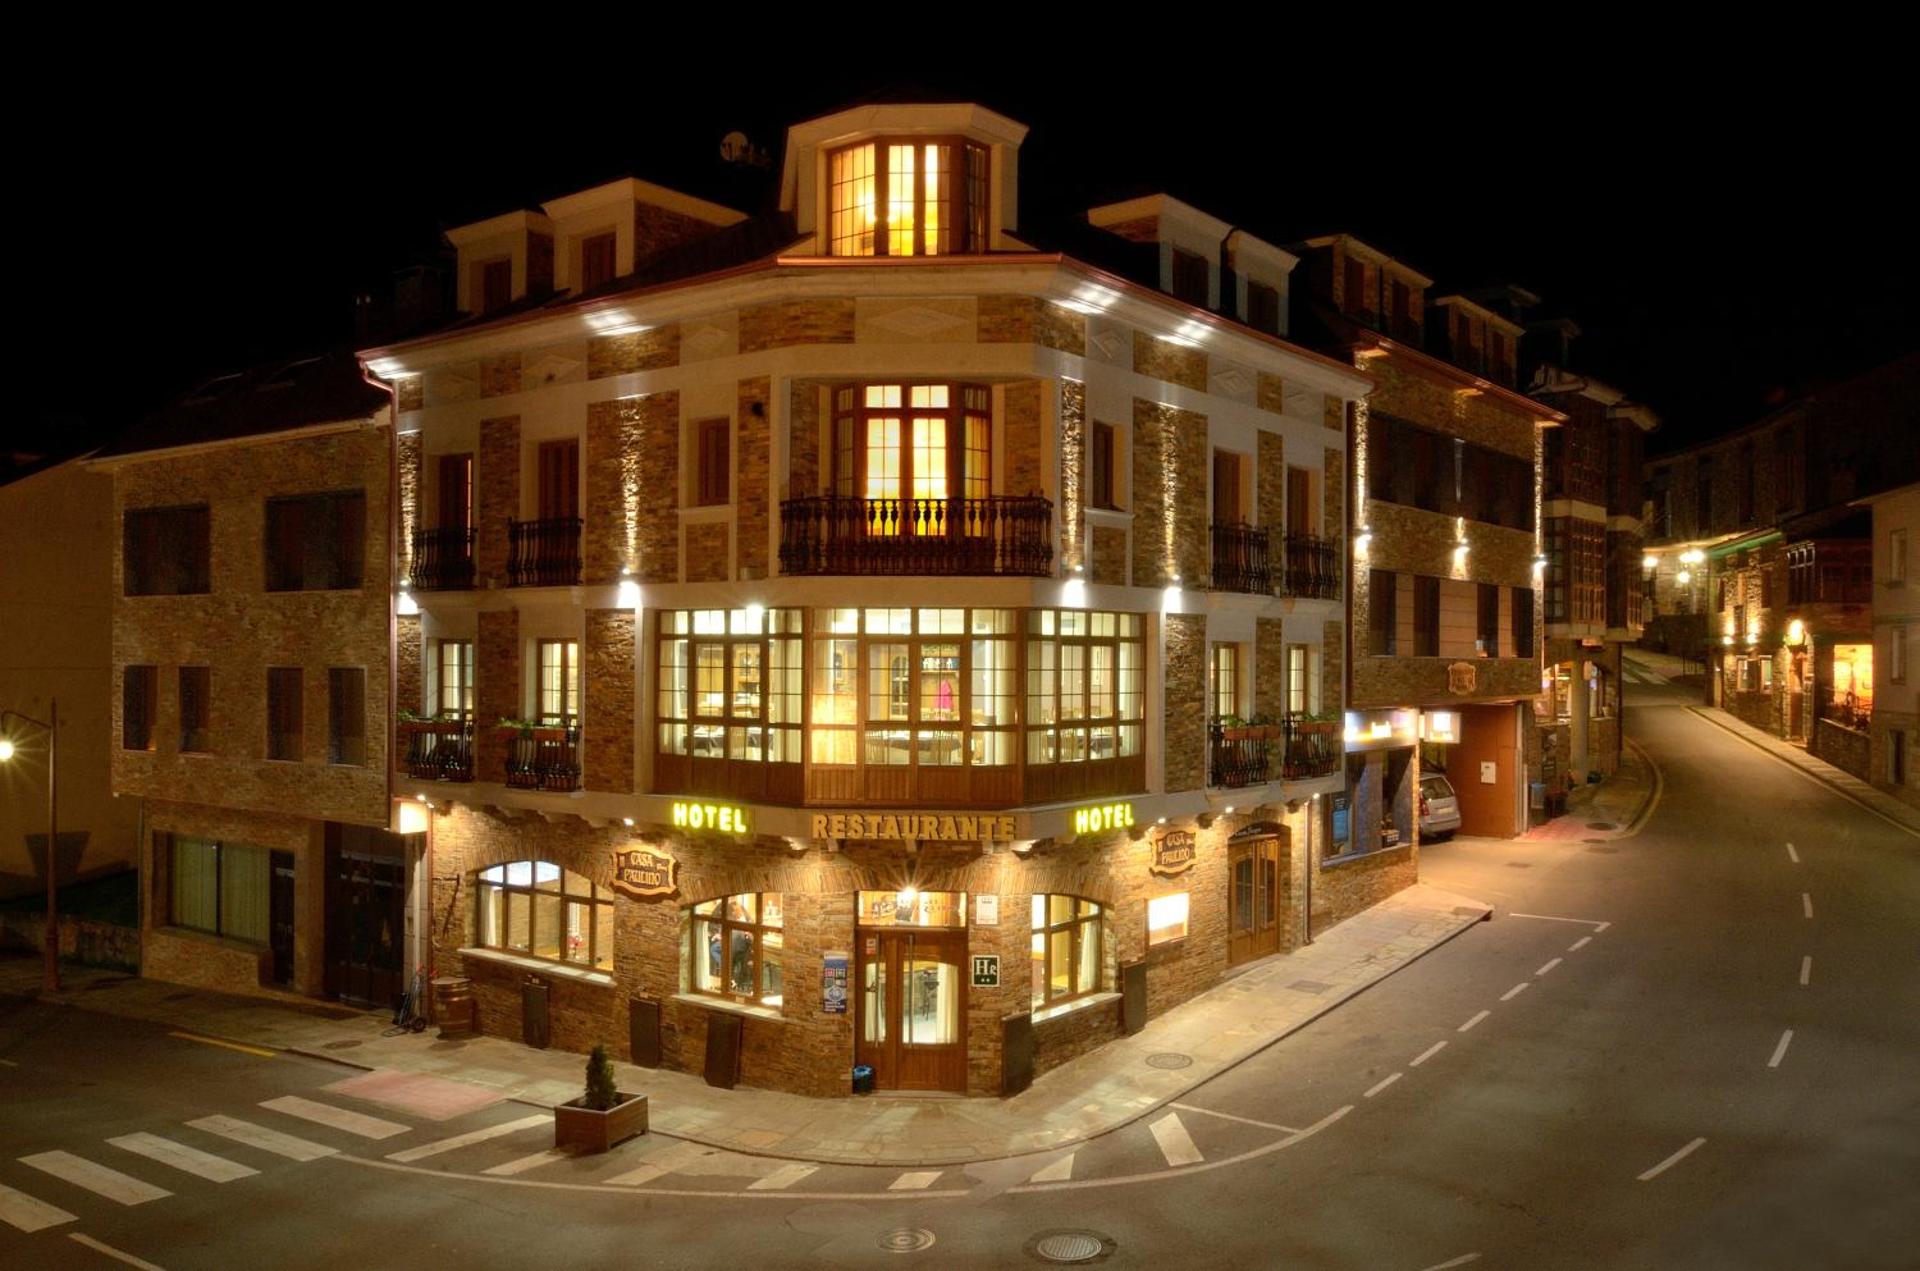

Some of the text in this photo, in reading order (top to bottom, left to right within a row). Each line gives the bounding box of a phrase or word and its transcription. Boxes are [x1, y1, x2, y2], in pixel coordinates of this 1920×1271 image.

[673, 803, 747, 833] HOTEL
[812, 814, 1016, 841] RESTAURANTE
[1076, 803, 1135, 834] HOTEL
[1167, 832, 1185, 847] CASA
[630, 851, 653, 868] CASA
[623, 868, 661, 887] PAULINO
